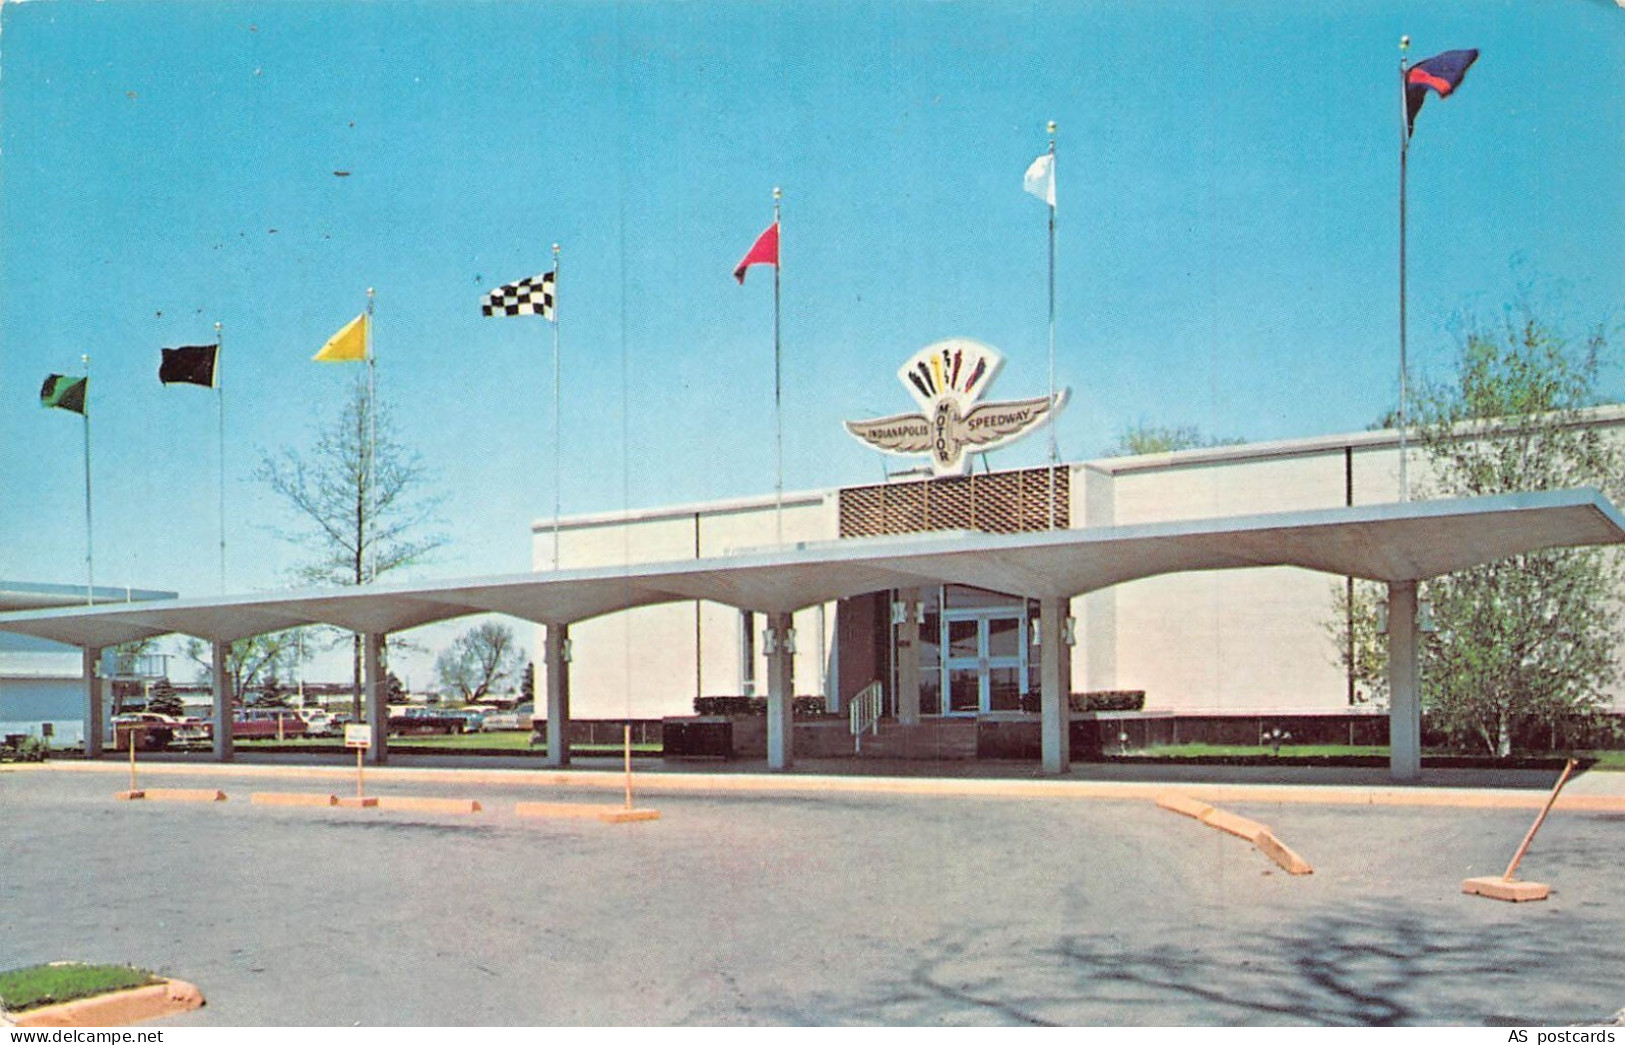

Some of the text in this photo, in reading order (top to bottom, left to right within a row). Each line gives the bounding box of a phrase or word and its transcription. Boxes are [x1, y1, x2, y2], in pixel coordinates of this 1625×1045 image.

[968, 409, 1030, 431] SPEEDWAY
[868, 424, 929, 439] INDIANAPOLIS
[936, 404, 949, 462] MOTOR
